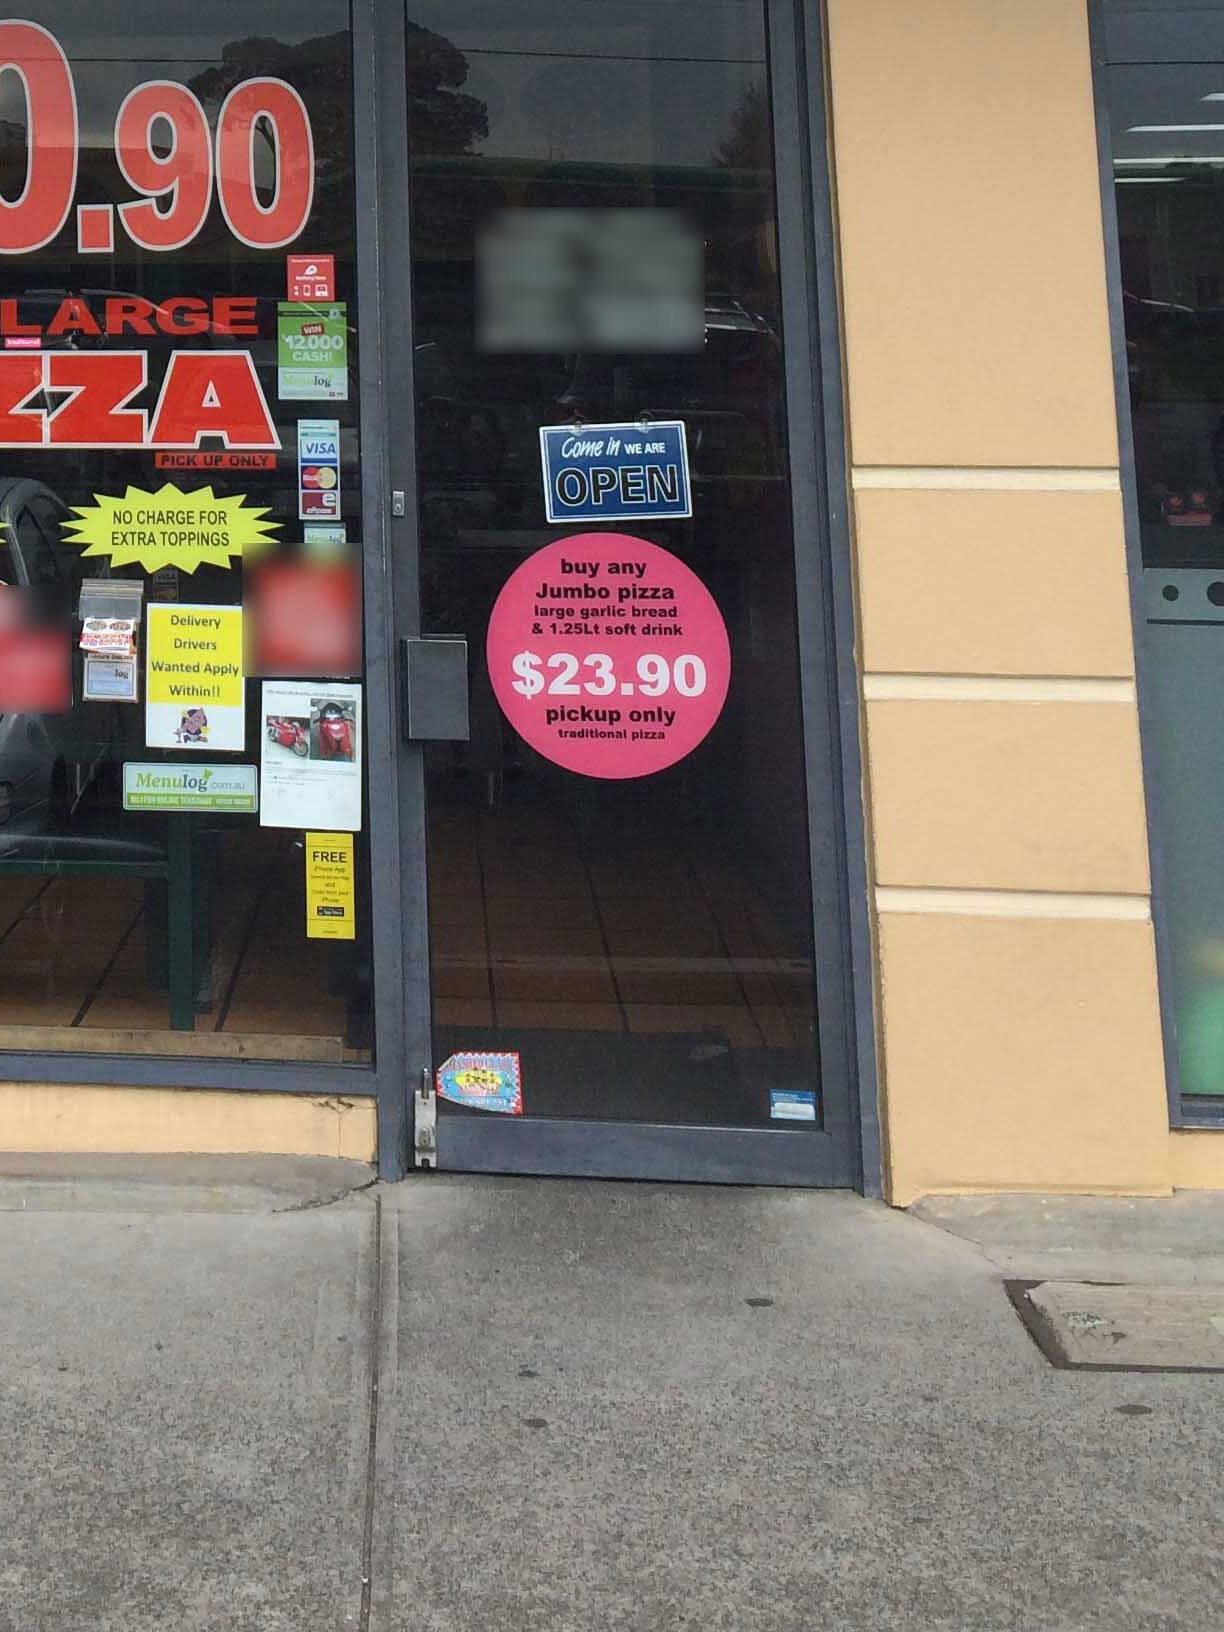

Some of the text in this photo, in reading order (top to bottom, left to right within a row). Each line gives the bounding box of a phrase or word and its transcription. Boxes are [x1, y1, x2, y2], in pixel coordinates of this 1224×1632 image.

[0, 297, 258, 336] LARGE
[292, 352, 332, 362] CASH!
[306, 443, 336, 454] VISA
[561, 438, 665, 459] Come in WE ARE
[160, 455, 269, 467] PICK UP ONLY
[556, 464, 679, 507] OPEN
[113, 510, 227, 525] NO CHARGE FOR
[111, 532, 229, 547] EXTRA TOPPINGS
[561, 558, 646, 578] buy any
[536, 583, 674, 602] Jumbo pizza
[534, 605, 678, 619] large garlic bread
[171, 614, 221, 629] Delivery
[531, 623, 683, 635] & 1.25Lt soft drink
[174, 638, 217, 651] Drivers
[151, 661, 239, 677] Wanted Apply
[512, 651, 707, 699] $23.90
[169, 684, 220, 698] Within!!
[546, 706, 675, 725] pickup only
[558, 728, 665, 741] traditional pizza
[136, 772, 209, 792] Menulog
[312, 851, 347, 863] FREE
